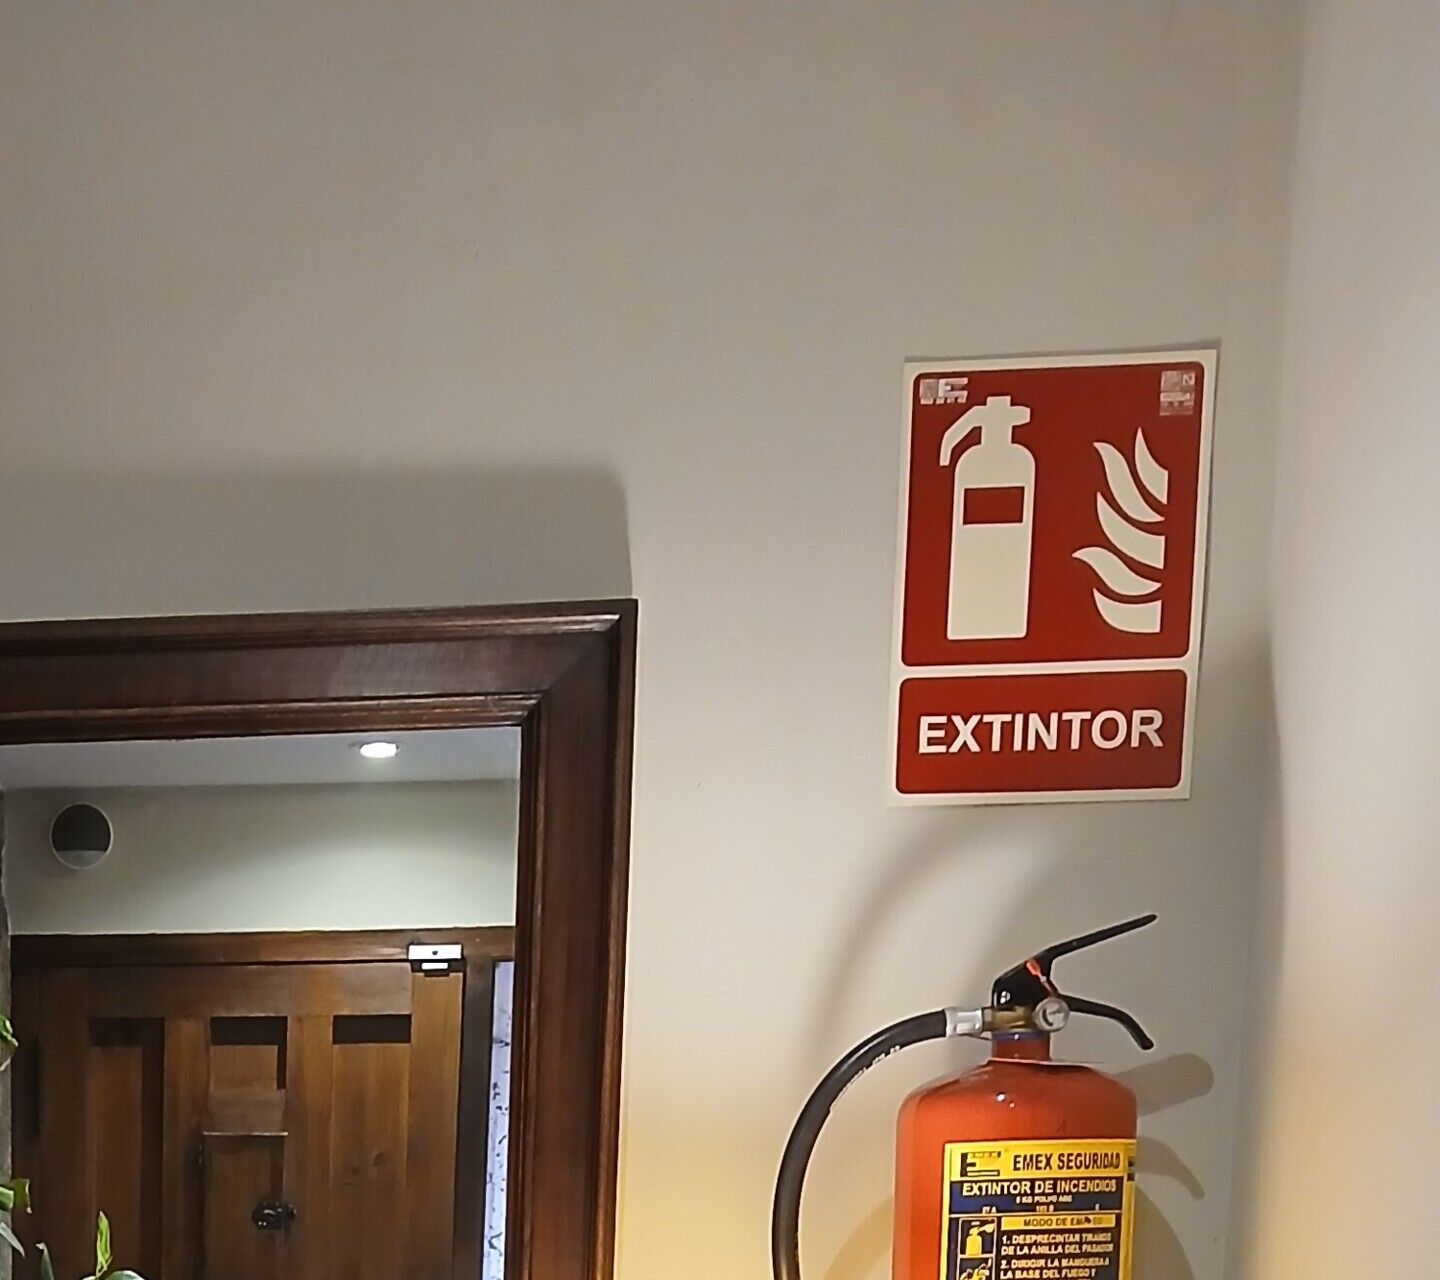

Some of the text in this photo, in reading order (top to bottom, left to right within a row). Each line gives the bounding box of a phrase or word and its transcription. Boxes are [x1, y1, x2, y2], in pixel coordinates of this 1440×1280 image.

[918, 709, 1164, 754] EXTINTOR
[1012, 1152, 1121, 1172] EMEX SEGURIDAD
[962, 1179, 1117, 1197] EXTINTOR DE INCENDIOS
[1023, 1217, 1053, 1227] MODO
[1055, 1217, 1068, 1226] DE
[1001, 1235, 1011, 1244] 1.
[1001, 1246, 1015, 1255] DE
[1016, 1246, 1029, 1255] LA
[1030, 1245, 1063, 1255] ANILLA
[1047, 1258, 1060, 1268] LA
[1000, 1270, 1014, 1280] LA
